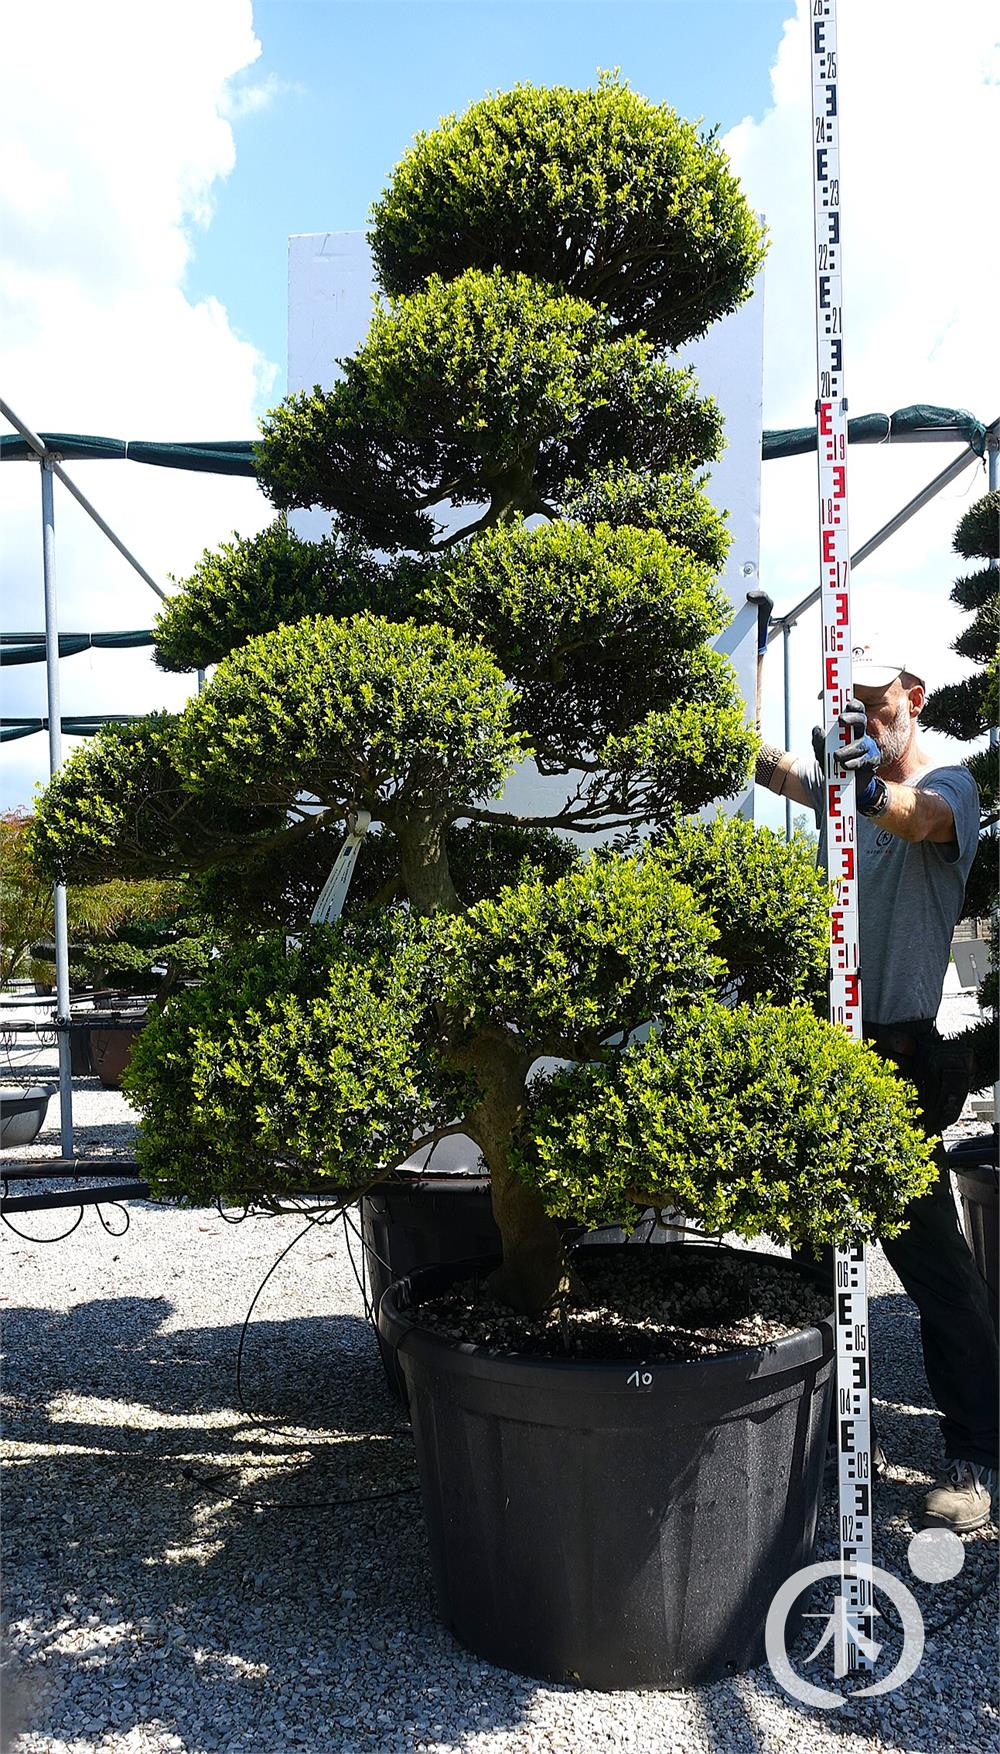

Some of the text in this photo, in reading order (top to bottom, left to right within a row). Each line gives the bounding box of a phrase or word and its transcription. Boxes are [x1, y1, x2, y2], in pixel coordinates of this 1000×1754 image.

[827, 52, 837, 79] 25
[815, 116, 825, 144] 24
[829, 179, 840, 206] 23
[818, 244, 828, 271] 22
[832, 307, 842, 334] 21
[820, 371, 831, 398] 20
[833, 433, 845, 461] 19
[821, 498, 833, 525] 18
[836, 561, 848, 588] 17
[824, 625, 836, 652] 16
[842, 815, 854, 842] 13
[830, 879, 842, 906] 2
[845, 942, 857, 969] 11
[837, 1261, 849, 1288] 06
[854, 1324, 866, 1351] 05
[627, 1370, 653, 1387] 10
[839, 1388, 851, 1415] 04
[857, 1451, 869, 1479] 03
[842, 1514, 854, 1542] 02
